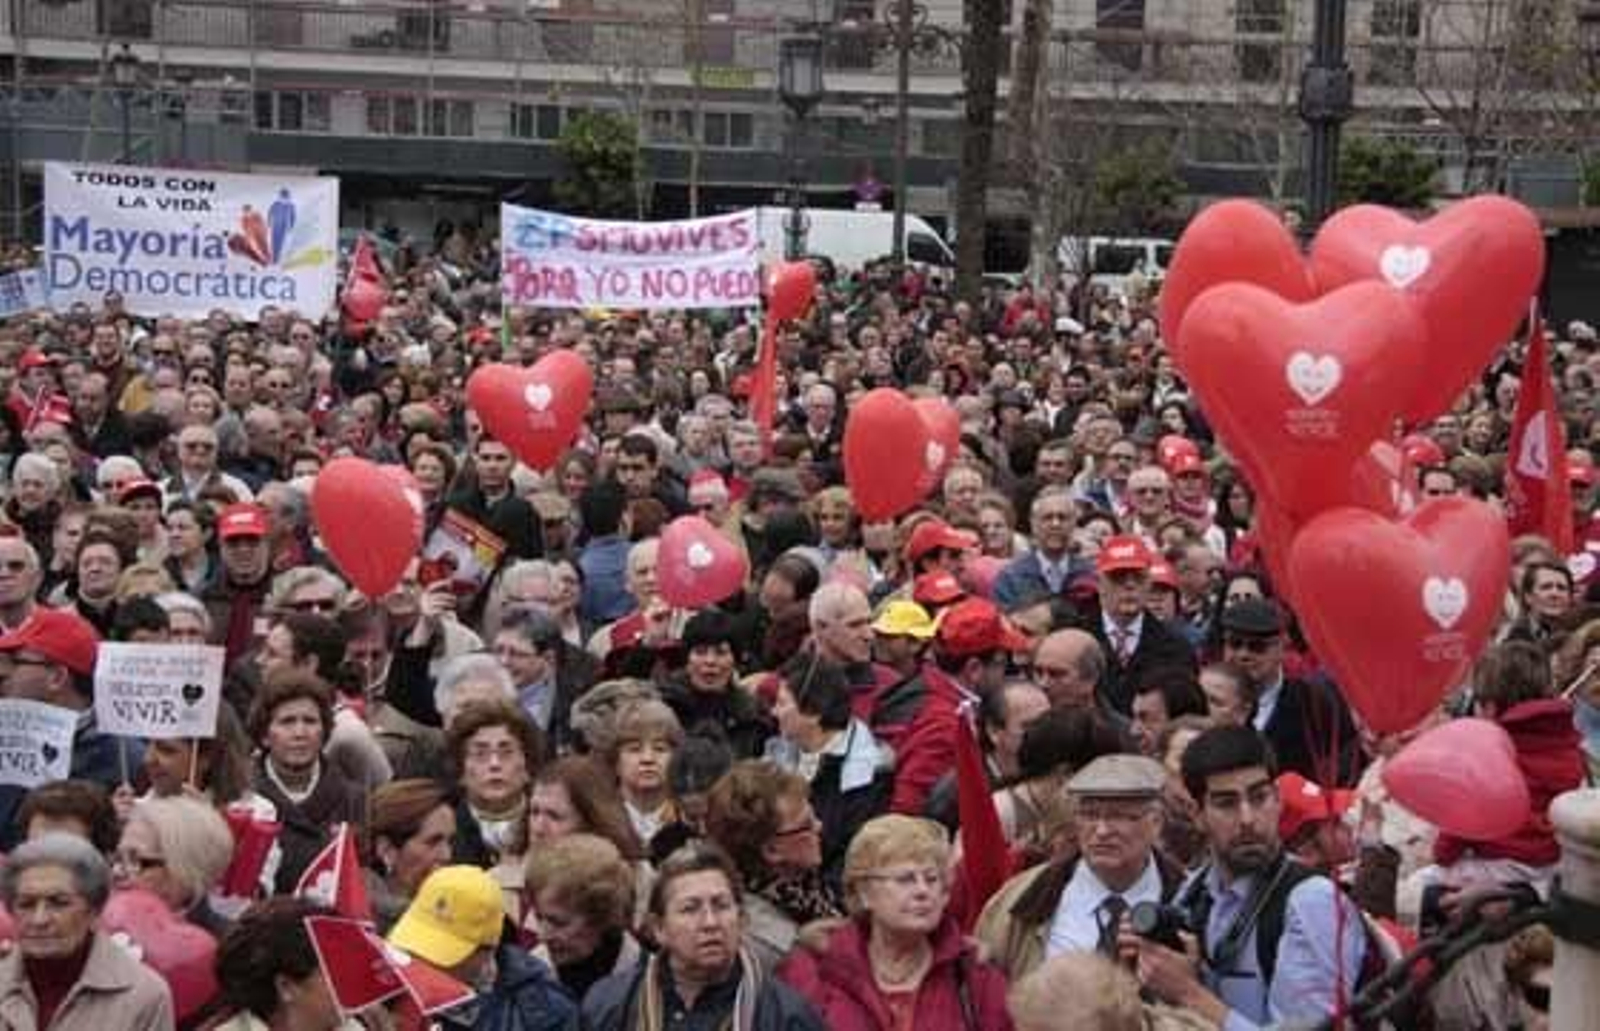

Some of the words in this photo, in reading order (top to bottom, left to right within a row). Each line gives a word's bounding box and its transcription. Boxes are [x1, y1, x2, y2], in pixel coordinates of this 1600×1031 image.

[72, 170, 155, 189] TODOS
[164, 177, 215, 192] CON
[118, 196, 148, 208] LA
[156, 198, 211, 211] VIDA
[52, 216, 227, 264] Mayoría
[50, 253, 297, 300] Democrática
[585, 266, 631, 297] YO
[641, 269, 687, 298] NO
[112, 699, 177, 724] VIVIR
